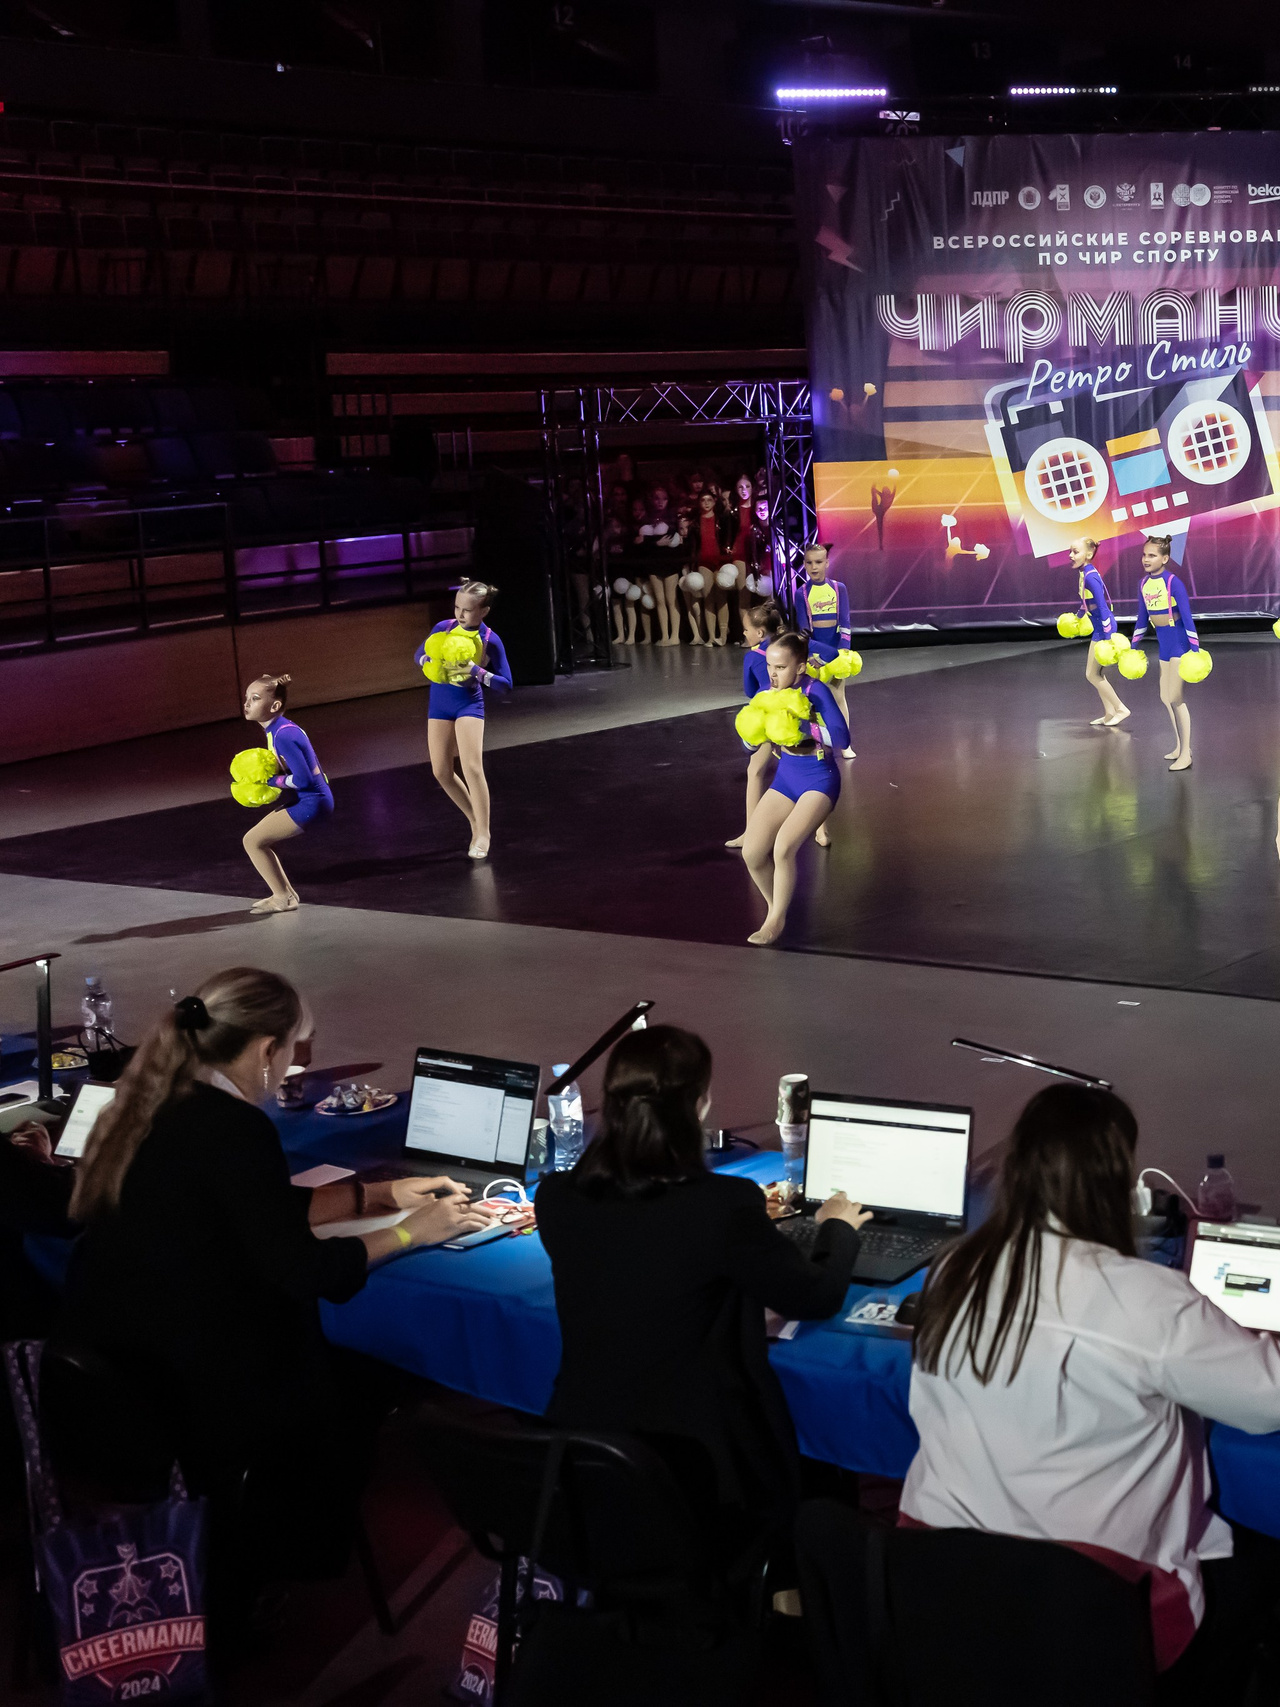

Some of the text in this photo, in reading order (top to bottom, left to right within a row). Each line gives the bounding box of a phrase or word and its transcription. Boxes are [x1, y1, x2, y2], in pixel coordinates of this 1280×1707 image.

[971, 191, 1009, 207] ЛДПР
[933, 230, 1129, 250] ВСЕРОССИЙСКИЕ
[1038, 247, 1220, 266] ПО ЧИР СПОРТУ
[1027, 340, 1253, 400] Ретро Стиль
[64, 1620, 205, 1674] CHEERMANIA
[121, 1675, 161, 1700] 2024
[460, 1671, 486, 1697] 2024
